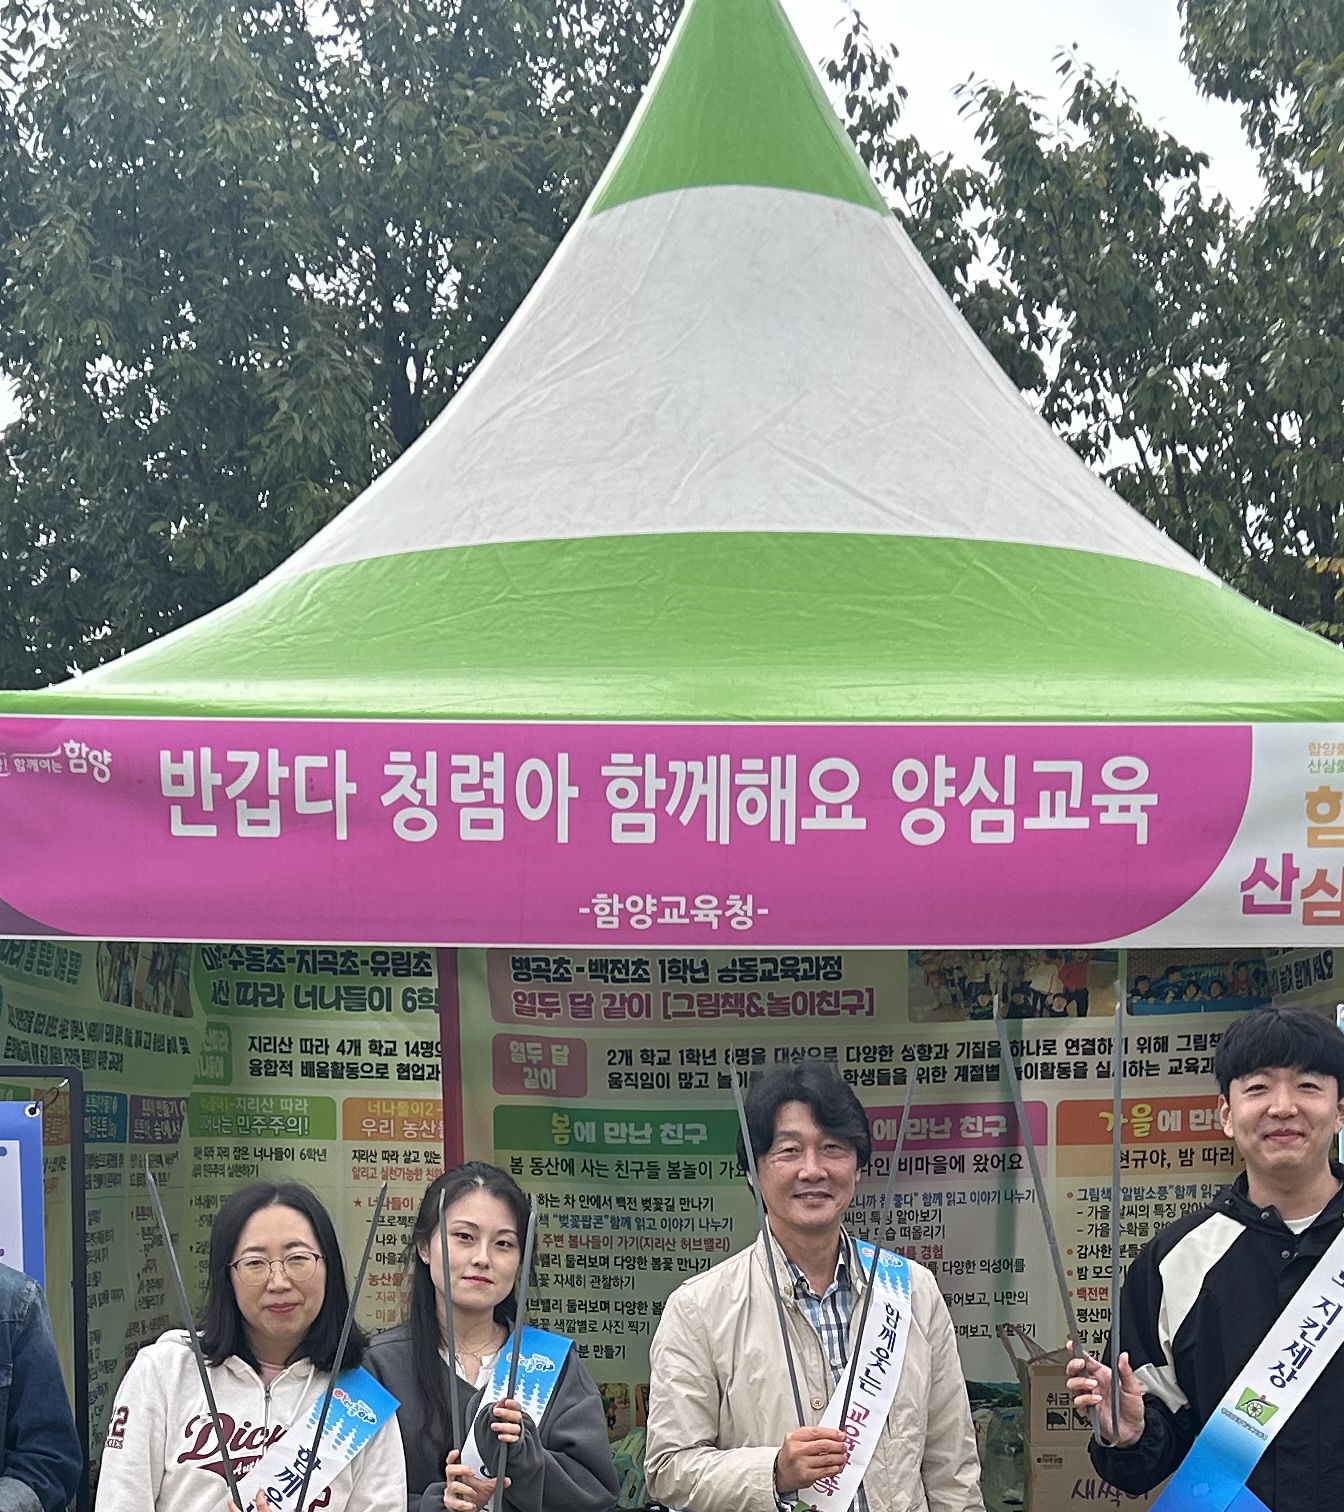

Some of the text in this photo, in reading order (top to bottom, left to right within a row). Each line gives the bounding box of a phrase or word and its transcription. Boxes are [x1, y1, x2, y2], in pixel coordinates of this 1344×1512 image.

[63, 739, 113, 784] 함양
[159, 746, 1159, 846] 반갑다 청렴아 함께해요 양심교육
[577, 893, 769, 931] -함양교육청-
[658, 957, 710, 985] 1학년
[235, 981, 392, 1013] 따라 너나들이
[513, 991, 562, 1019] 열두
[568, 991, 595, 1020] 달
[602, 991, 653, 1020] 같이
[248, 1035, 398, 1058] 지리산 따라 4개 학교
[509, 1039, 570, 1066] 열두 달
[607, 1048, 633, 1067] 2개
[639, 1048, 672, 1067] 학교
[678, 1048, 717, 1067] 1학년
[774, 1046, 840, 1065] 대상으로
[846, 1043, 894, 1064] 다양한
[956, 1040, 1002, 1060] 기질을
[1009, 1038, 1056, 1058] 하나로
[1136, 1035, 1169, 1056] 위해
[248, 1059, 390, 1080] 융합적 배움활동으로
[522, 1066, 557, 1091] 같이
[607, 1063, 1000, 1091] 움직임이 많고 학생들을 위한 계절별
[237, 1115, 310, 1136] 민주주의!
[360, 1117, 395, 1138] 우리
[551, 1112, 709, 1146] 봄에 만난 친구
[904, 1113, 1008, 1140] 만난 친구
[253, 1147, 295, 1162] 너나들이
[898, 1152, 1024, 1176] 비마을에 왔어요
[1178, 1146, 1235, 1168] 밤 따러
[509, 1156, 713, 1180] 봄 동산에 사는 친구들 봄놀이
[578, 1194, 715, 1212] 안에서 백전 만나기
[921, 1188, 1036, 1207] 함께 읽고 이야기 나누기
[896, 1209, 943, 1226] 알아보기
[1153, 1203, 1177, 1218] 특징
[635, 1216, 734, 1233] 읽고 이야기 나누기
[542, 1233, 613, 1249] 주변 봄나들이
[564, 1253, 713, 1272] 둘러보며 다양한 만나기
[920, 1244, 944, 1260] 경험
[1076, 1245, 1112, 1260] 감사한
[942, 1259, 977, 1276] 다양한
[553, 1273, 636, 1290] 자세히 관찰하기
[565, 1298, 649, 1315] 둘러보며 다양한
[993, 1290, 1029, 1306] 나만의
[601, 1319, 625, 1335] 사진
[628, 1319, 651, 1336] 찍기
[592, 1343, 627, 1360] 만들기
[857, 1301, 905, 1398] 함께웃는
